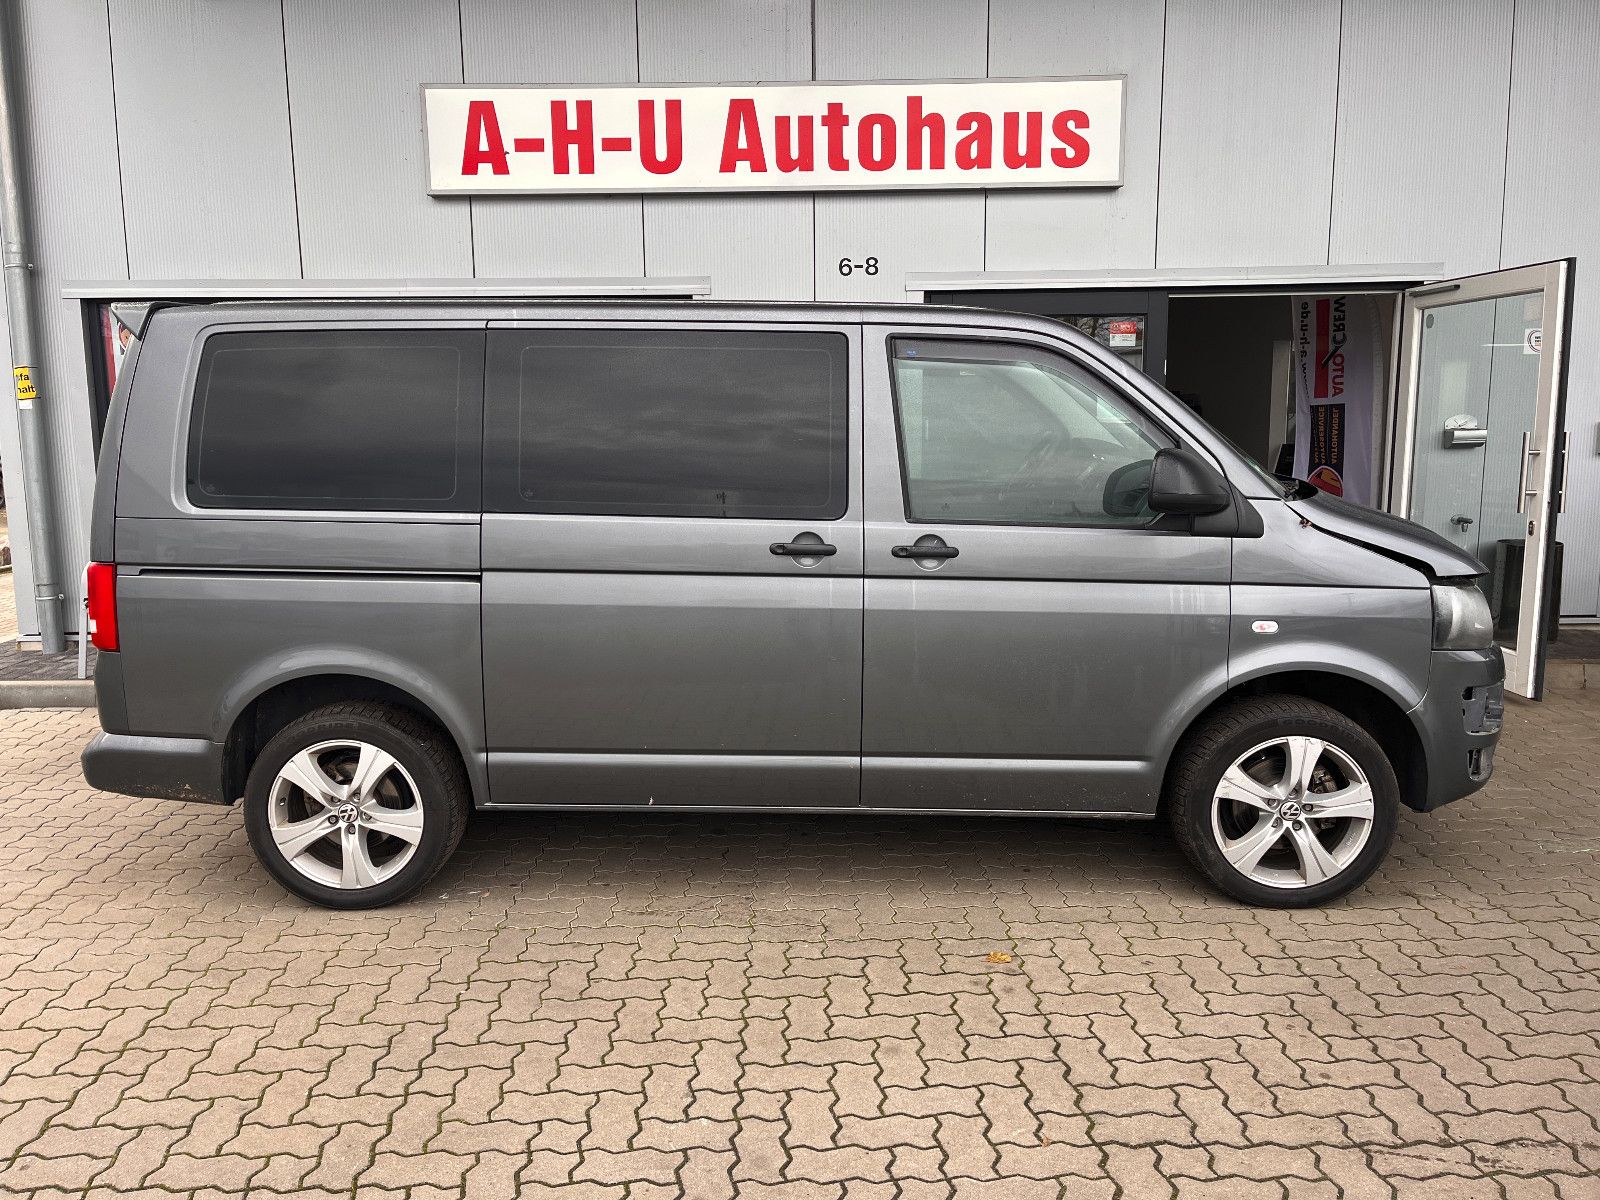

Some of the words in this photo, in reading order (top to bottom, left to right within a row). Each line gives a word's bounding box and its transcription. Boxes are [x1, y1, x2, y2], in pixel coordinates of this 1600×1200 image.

[461, 99, 683, 175] A-H-U
[719, 95, 1090, 173] Autohaus
[838, 256, 879, 277] 6-8
